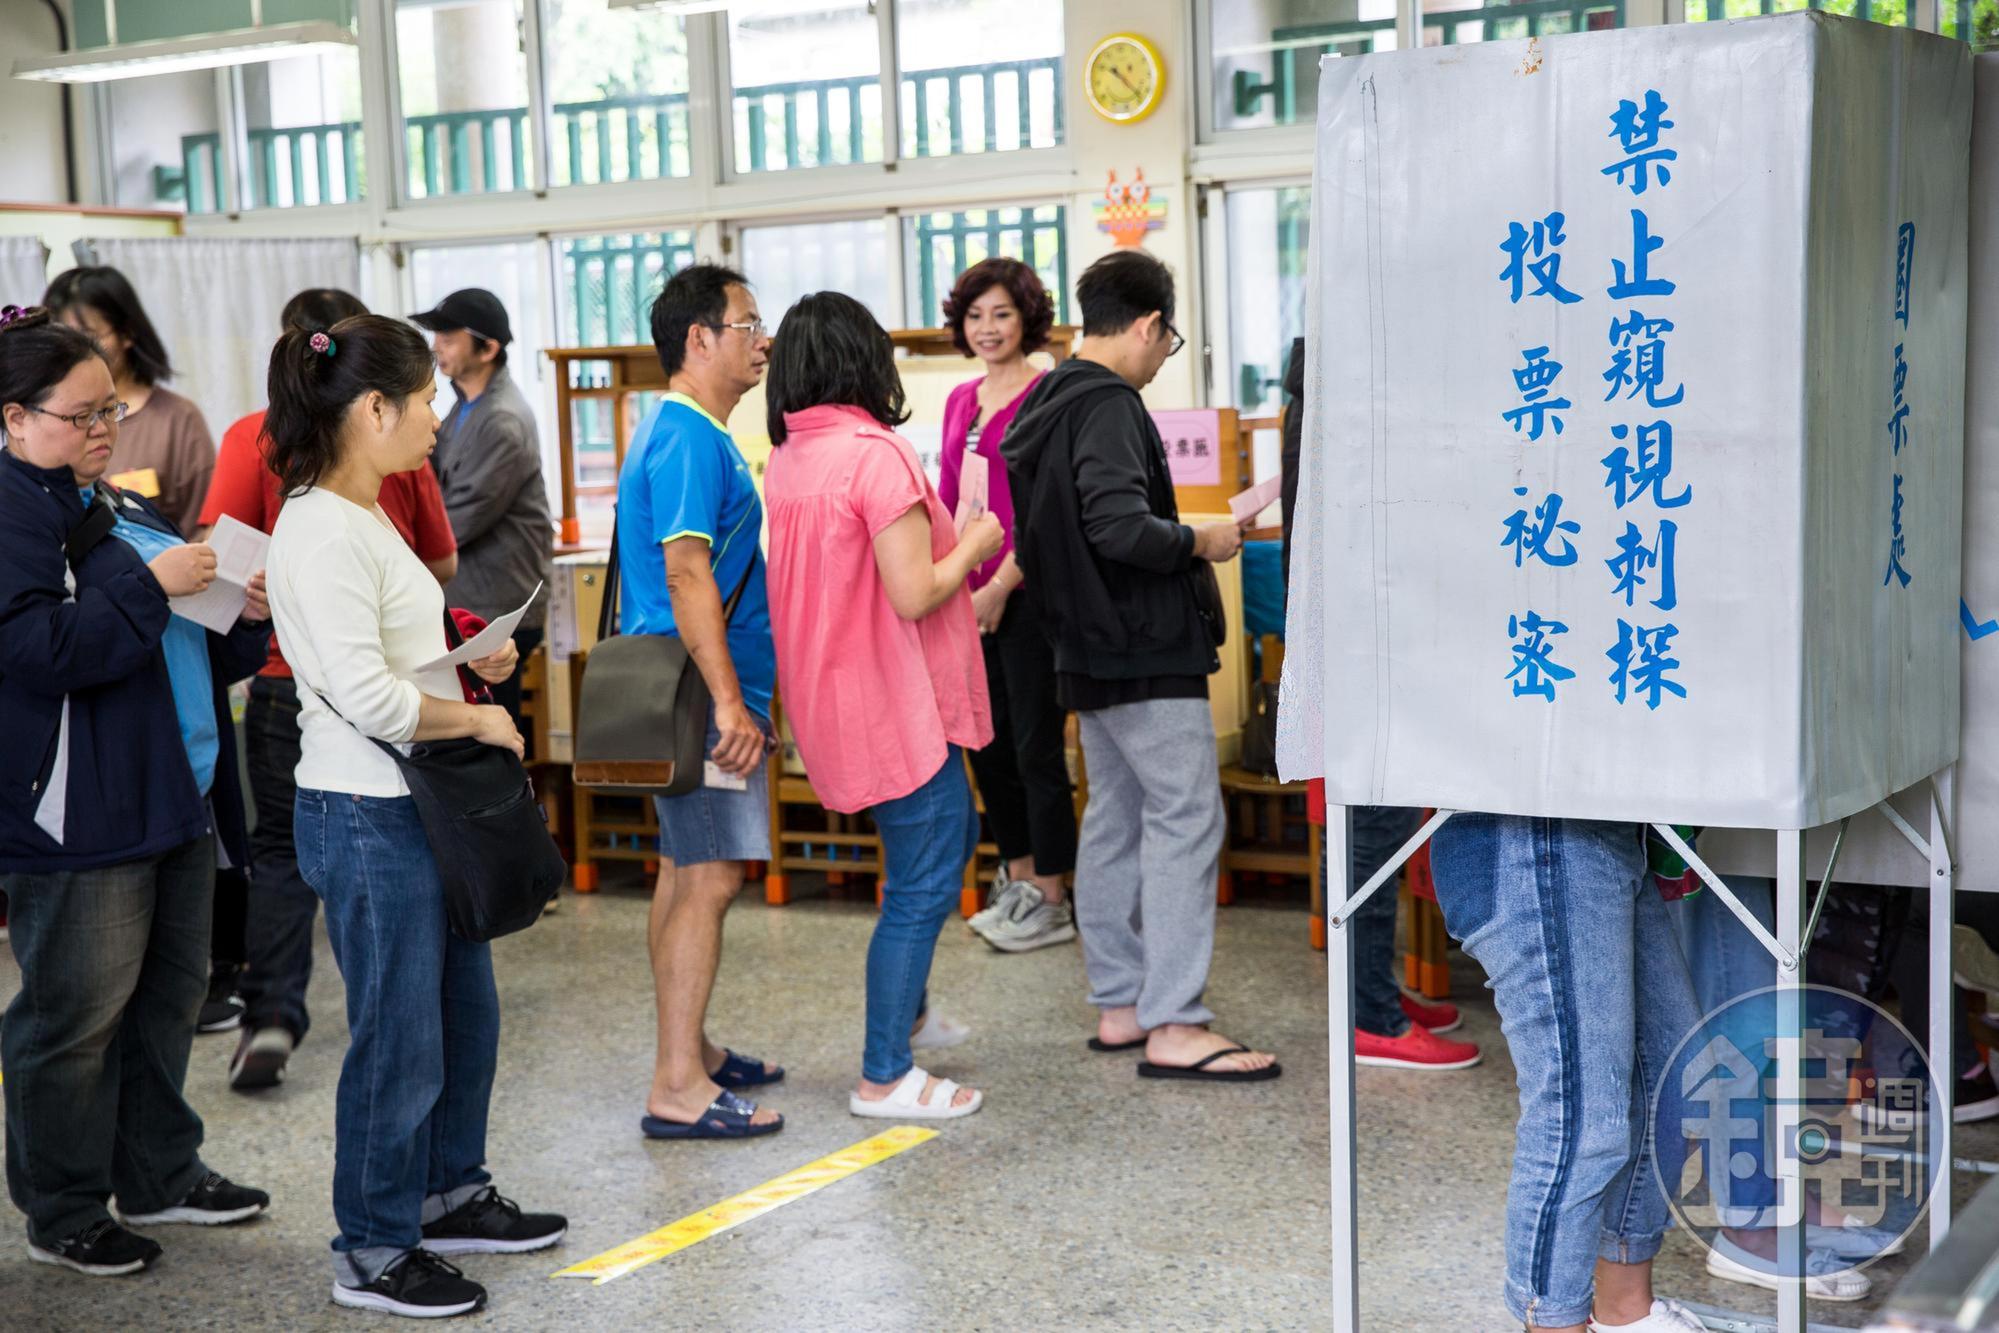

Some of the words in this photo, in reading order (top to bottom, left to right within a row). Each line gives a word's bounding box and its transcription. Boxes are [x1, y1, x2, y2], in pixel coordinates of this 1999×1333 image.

[1600, 89, 1693, 711] 禁止窺視刺探
